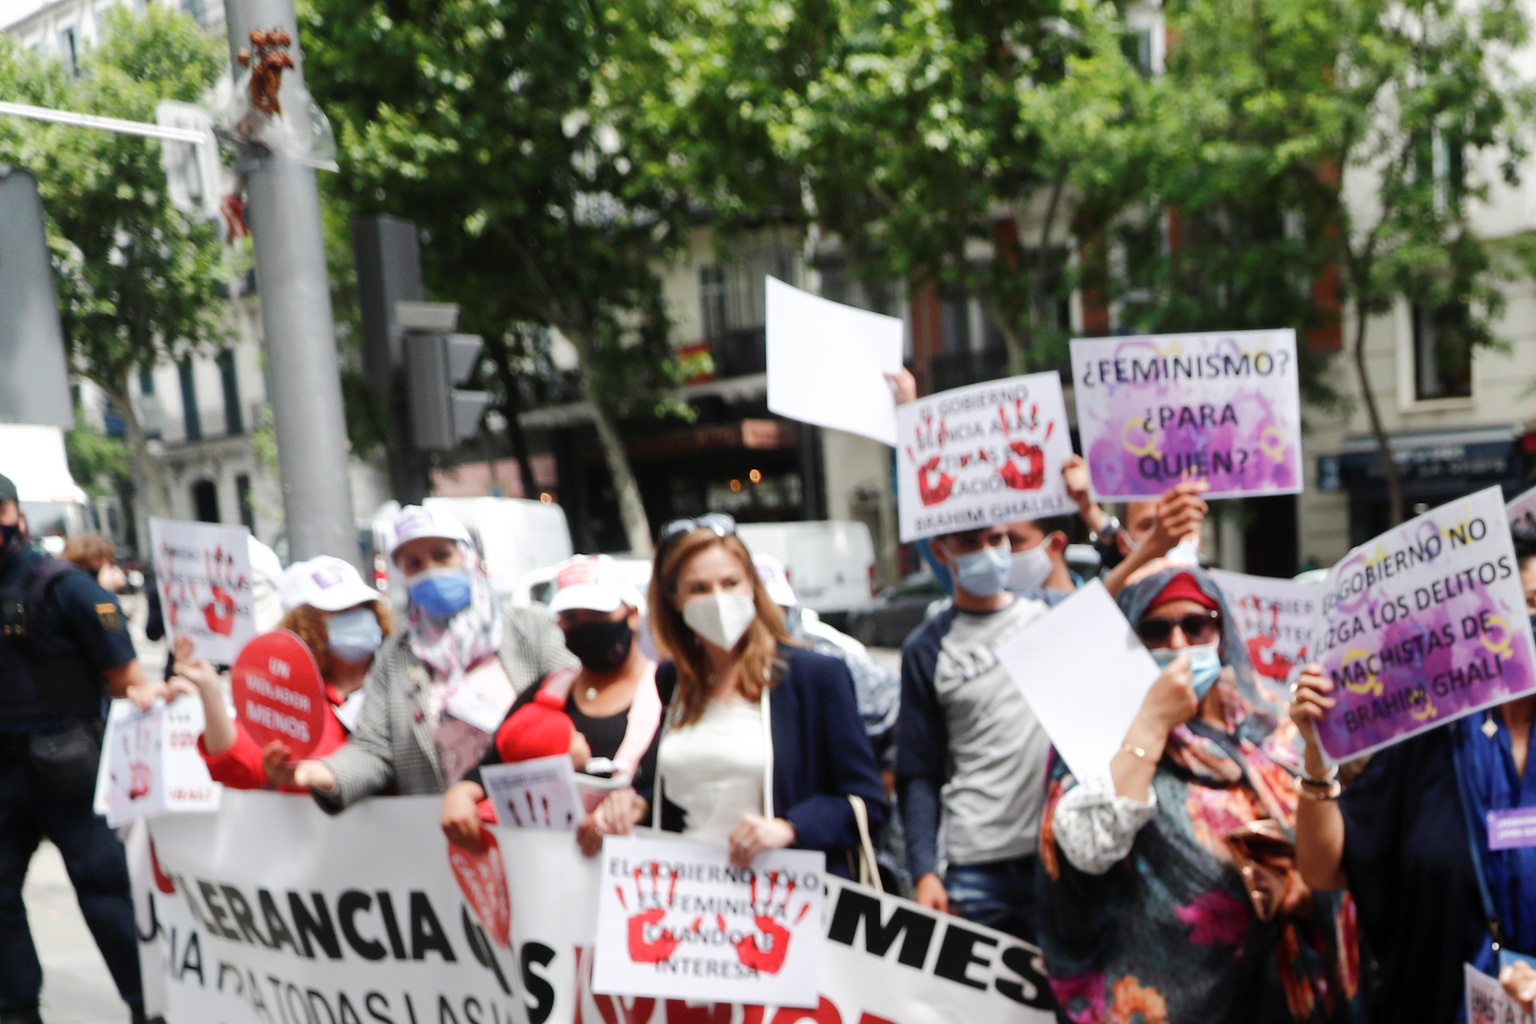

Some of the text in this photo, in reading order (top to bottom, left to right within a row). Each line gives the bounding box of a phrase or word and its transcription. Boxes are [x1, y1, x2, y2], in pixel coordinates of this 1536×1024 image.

[1082, 350, 1290, 388] ¿FEMINISMO?
[1142, 403, 1239, 433] ¿PARA
[1339, 535, 1442, 602] GOBIERNO
[1449, 517, 1488, 549] NO
[1369, 598, 1410, 631] LOS
[1415, 555, 1512, 612] DELITOS
[1331, 623, 1456, 692] MACHISTAS
[1461, 609, 1495, 641] DE
[1343, 654, 1504, 734] BRAHIM GHALI
[245, 699, 311, 743] MENOS
[609, 857, 629, 878] EL
[636, 859, 757, 885] GOBIERNO
[668, 893, 788, 919] FEMINISTA
[655, 956, 762, 981] INTERESA
[826, 886, 1056, 1012] MES
